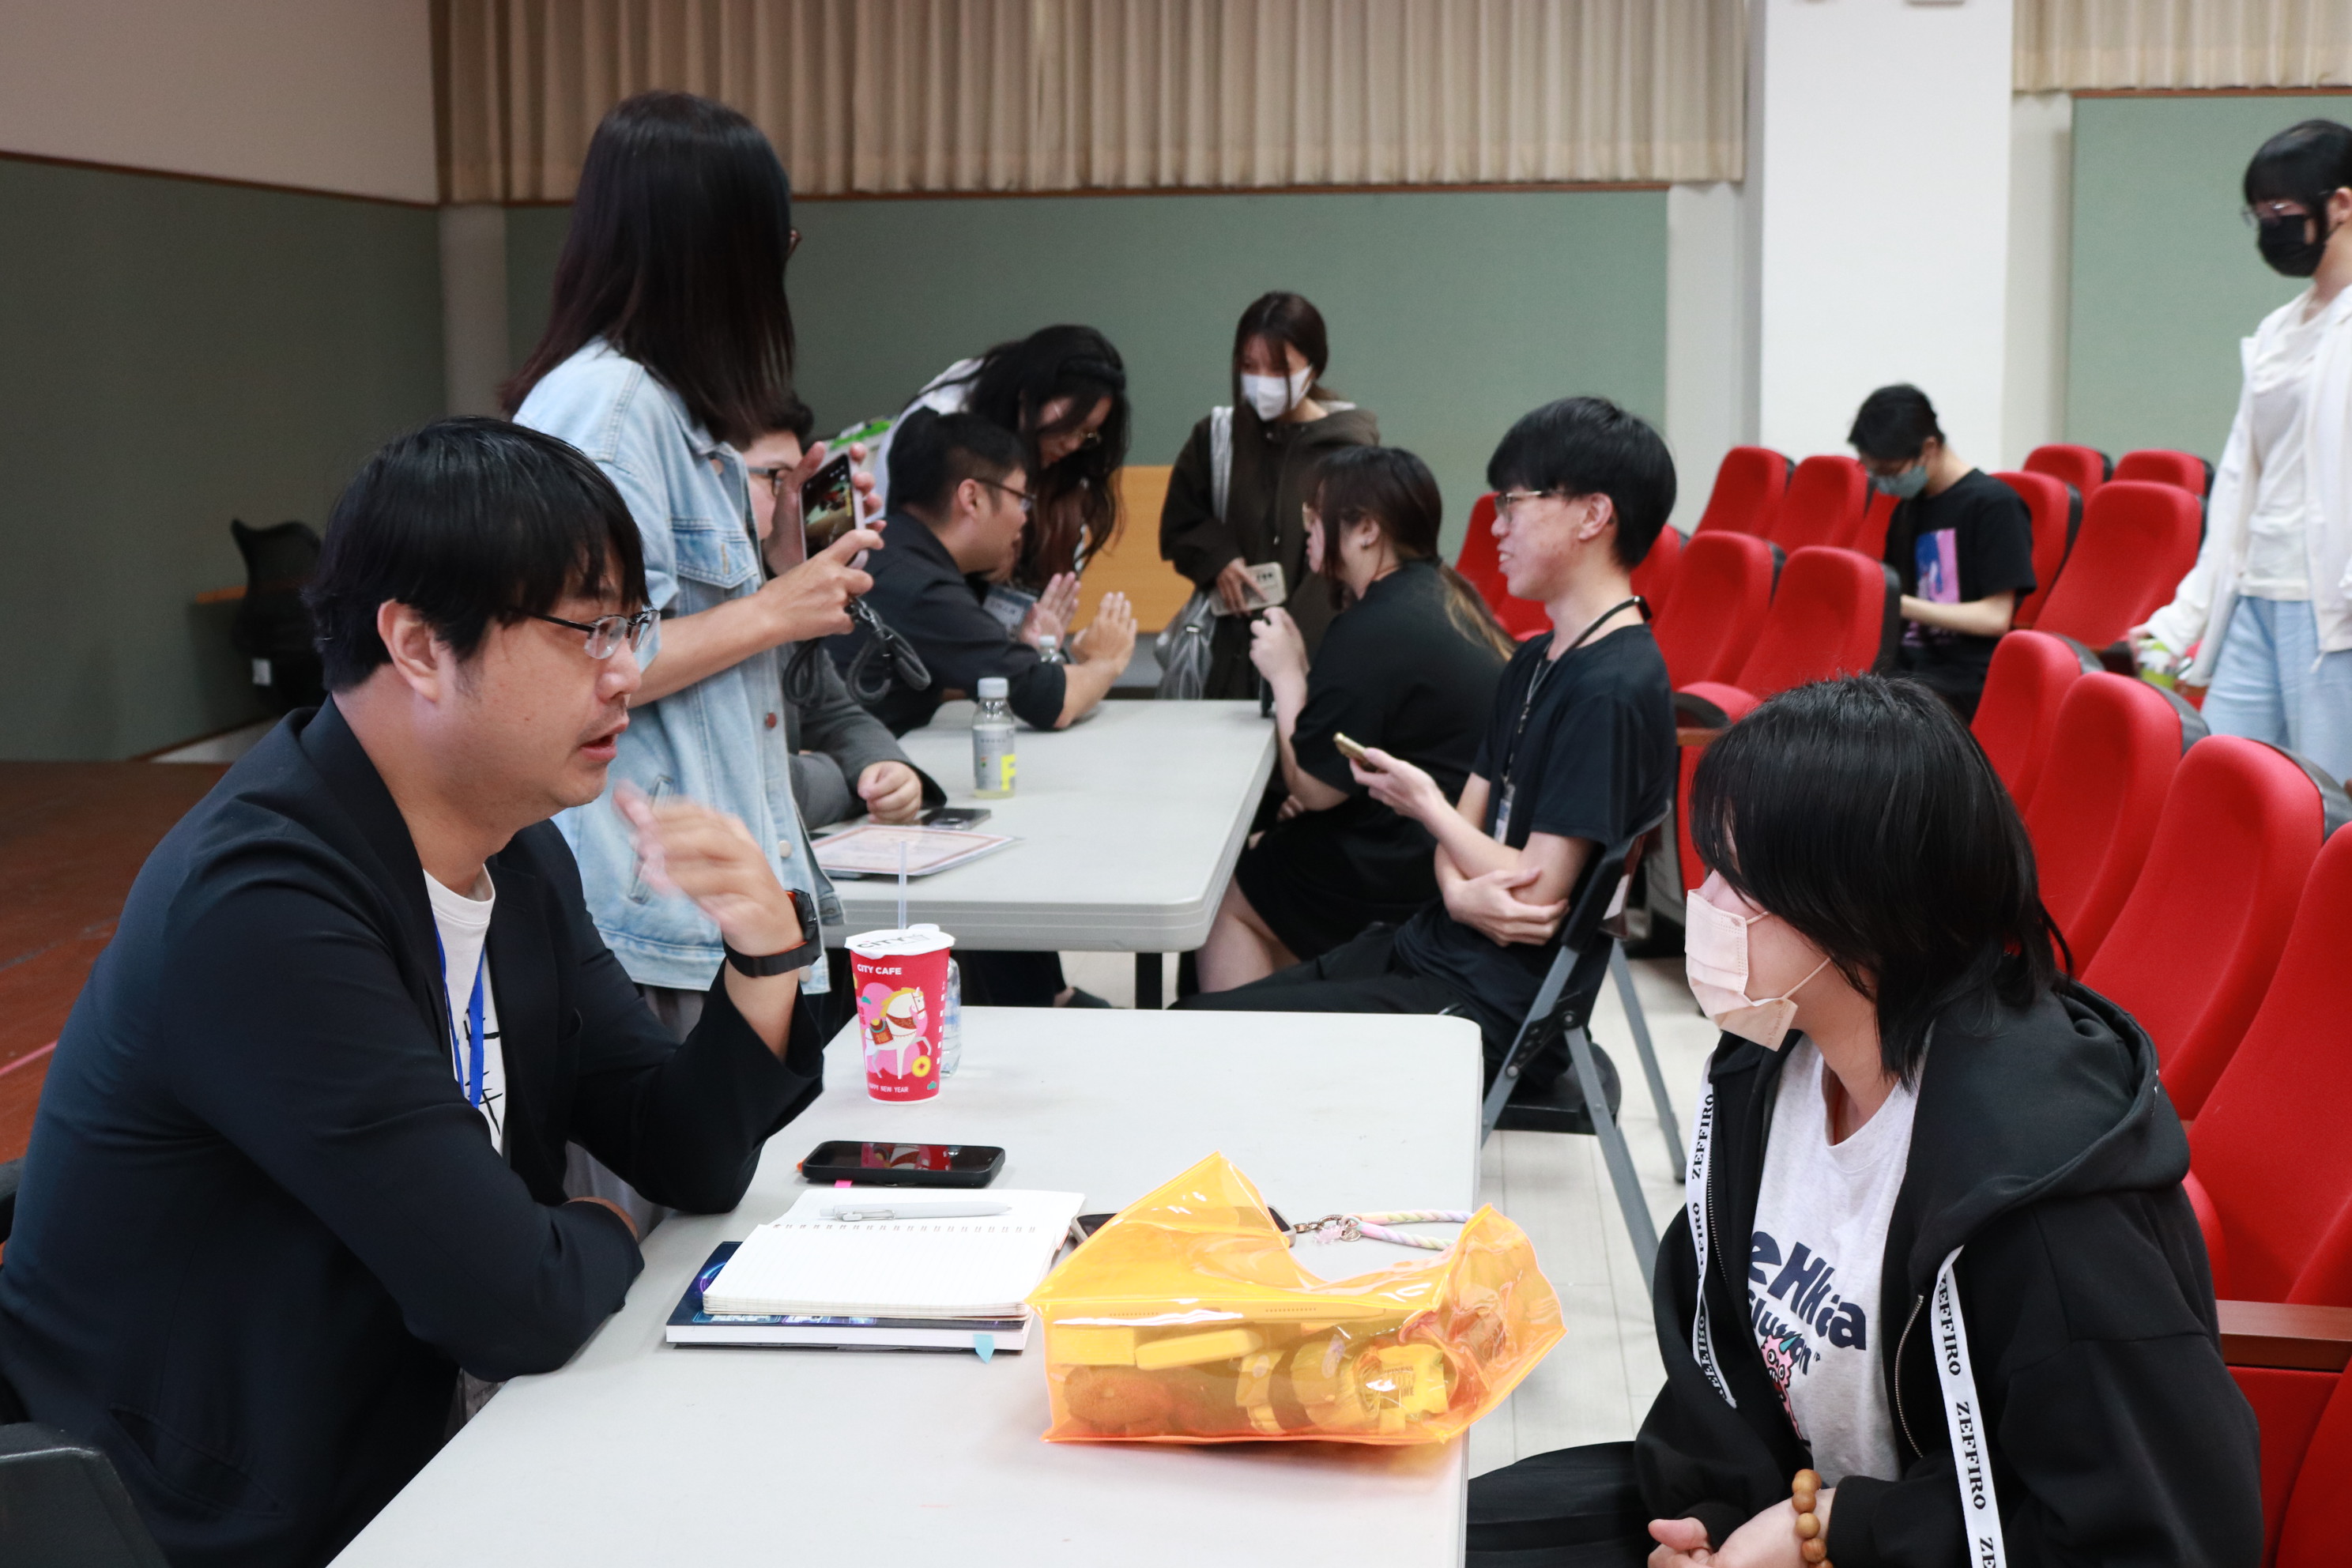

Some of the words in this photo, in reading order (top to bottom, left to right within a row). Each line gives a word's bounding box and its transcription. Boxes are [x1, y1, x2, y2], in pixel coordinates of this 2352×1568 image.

[858, 964, 873, 974] CITY
[1692, 1094, 1713, 1179] ZEFFIRO
[1956, 1401, 1986, 1510] ZEFFIRO
